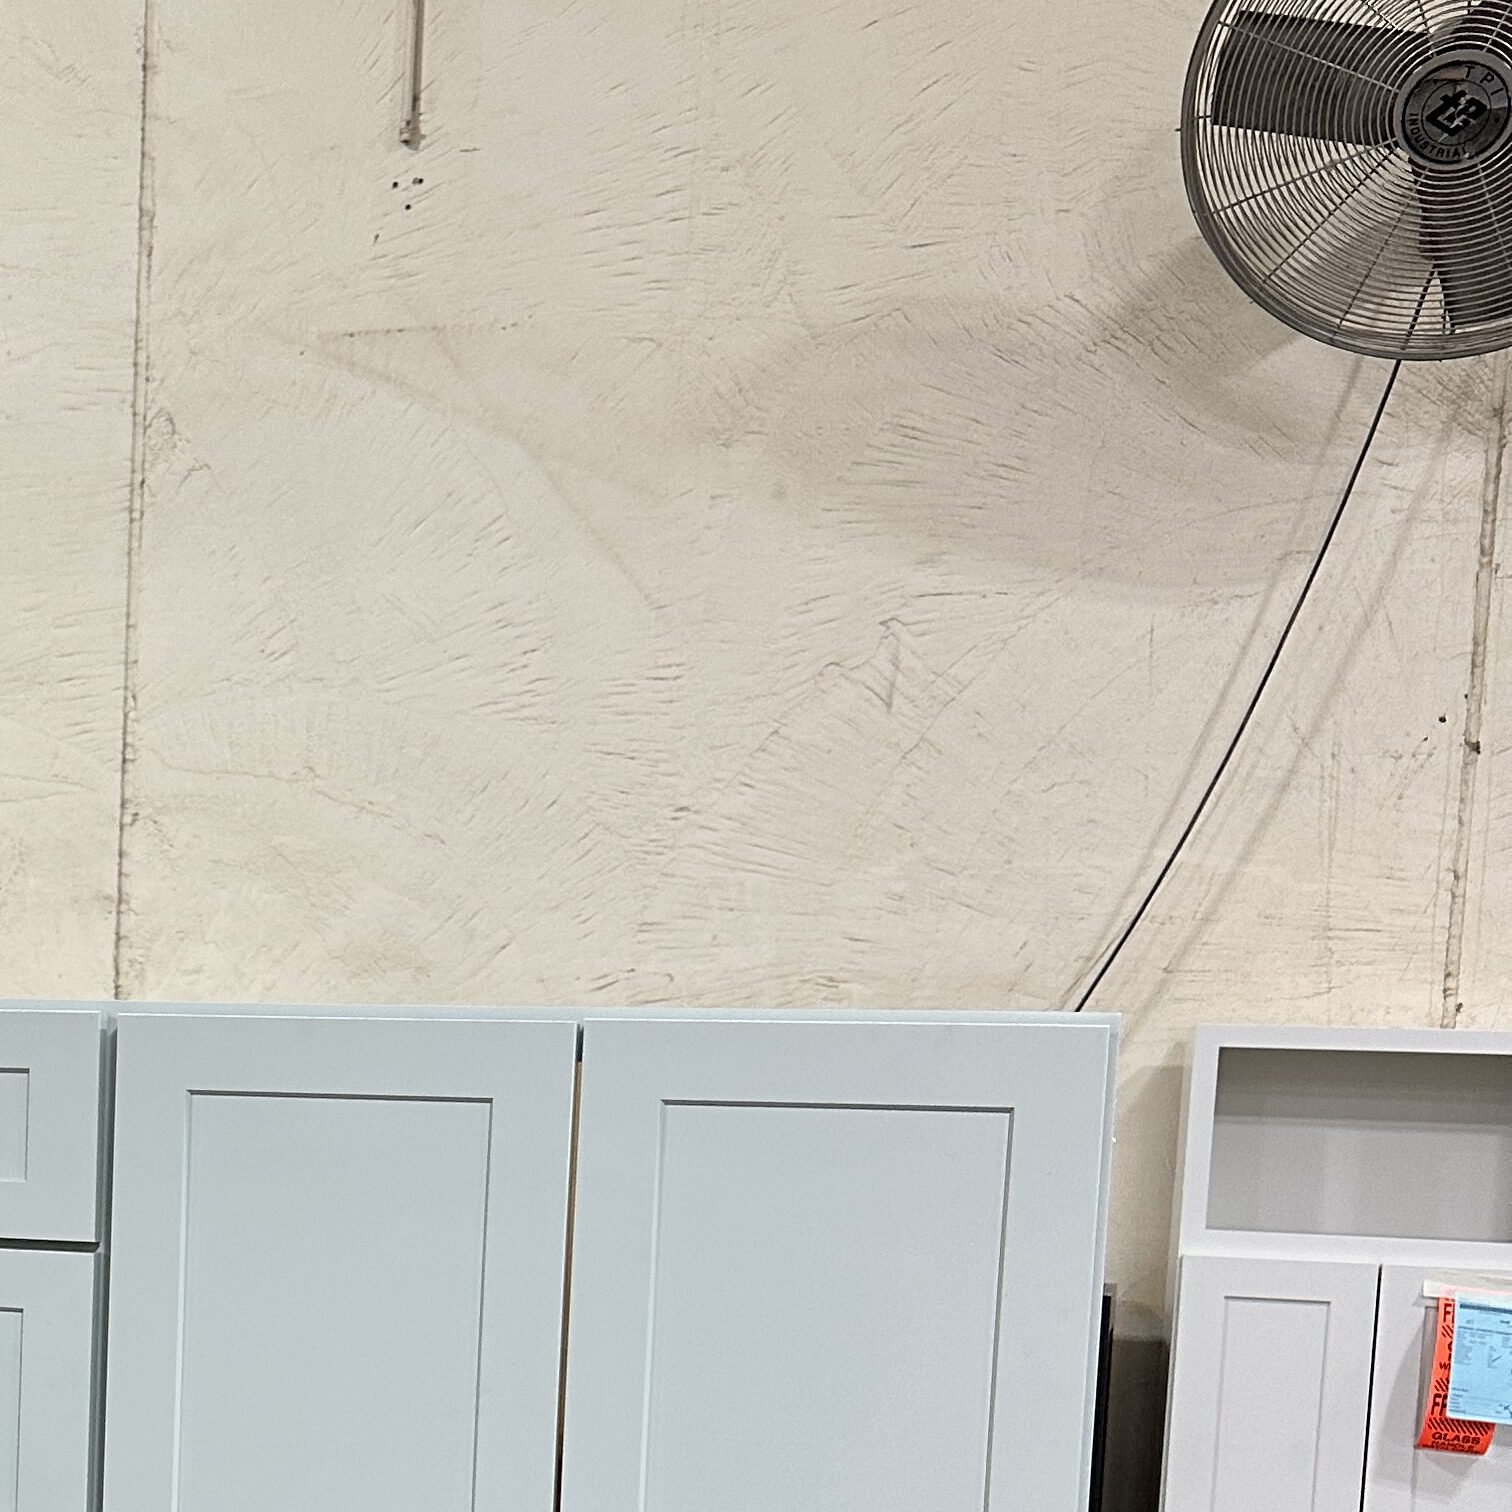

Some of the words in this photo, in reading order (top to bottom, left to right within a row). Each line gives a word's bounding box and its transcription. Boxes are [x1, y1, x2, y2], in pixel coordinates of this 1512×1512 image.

[1465, 65, 1504, 96] TPI
[1409, 113, 1467, 158] INDUSTRIAL
[1432, 1431, 1480, 1444] GLASS
